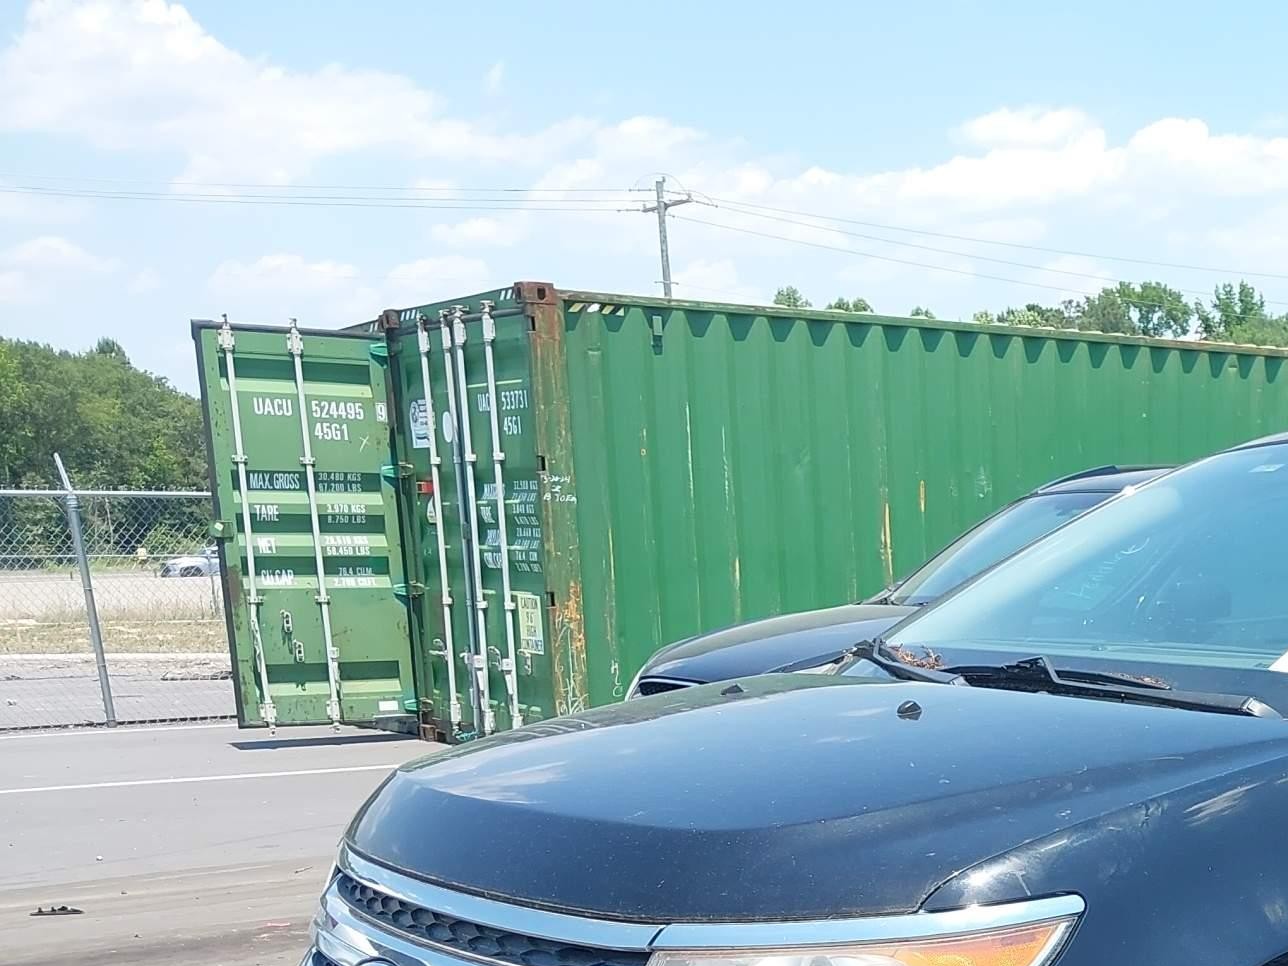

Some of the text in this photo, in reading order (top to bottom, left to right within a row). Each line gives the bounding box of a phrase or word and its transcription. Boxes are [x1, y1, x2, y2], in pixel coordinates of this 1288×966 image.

[501, 390, 528, 410] 533731
[253, 397, 387, 421] UACU 524495 9
[314, 423, 349, 440] 45G1
[503, 416, 521, 435] 45G1
[347, 473, 362, 481] KGS
[347, 484, 362, 492] LBS
[254, 505, 279, 521] TARE
[351, 505, 366, 513] KGS
[352, 515, 366, 523] LBS
[257, 537, 277, 554] NET
[356, 547, 370, 555] LBS
